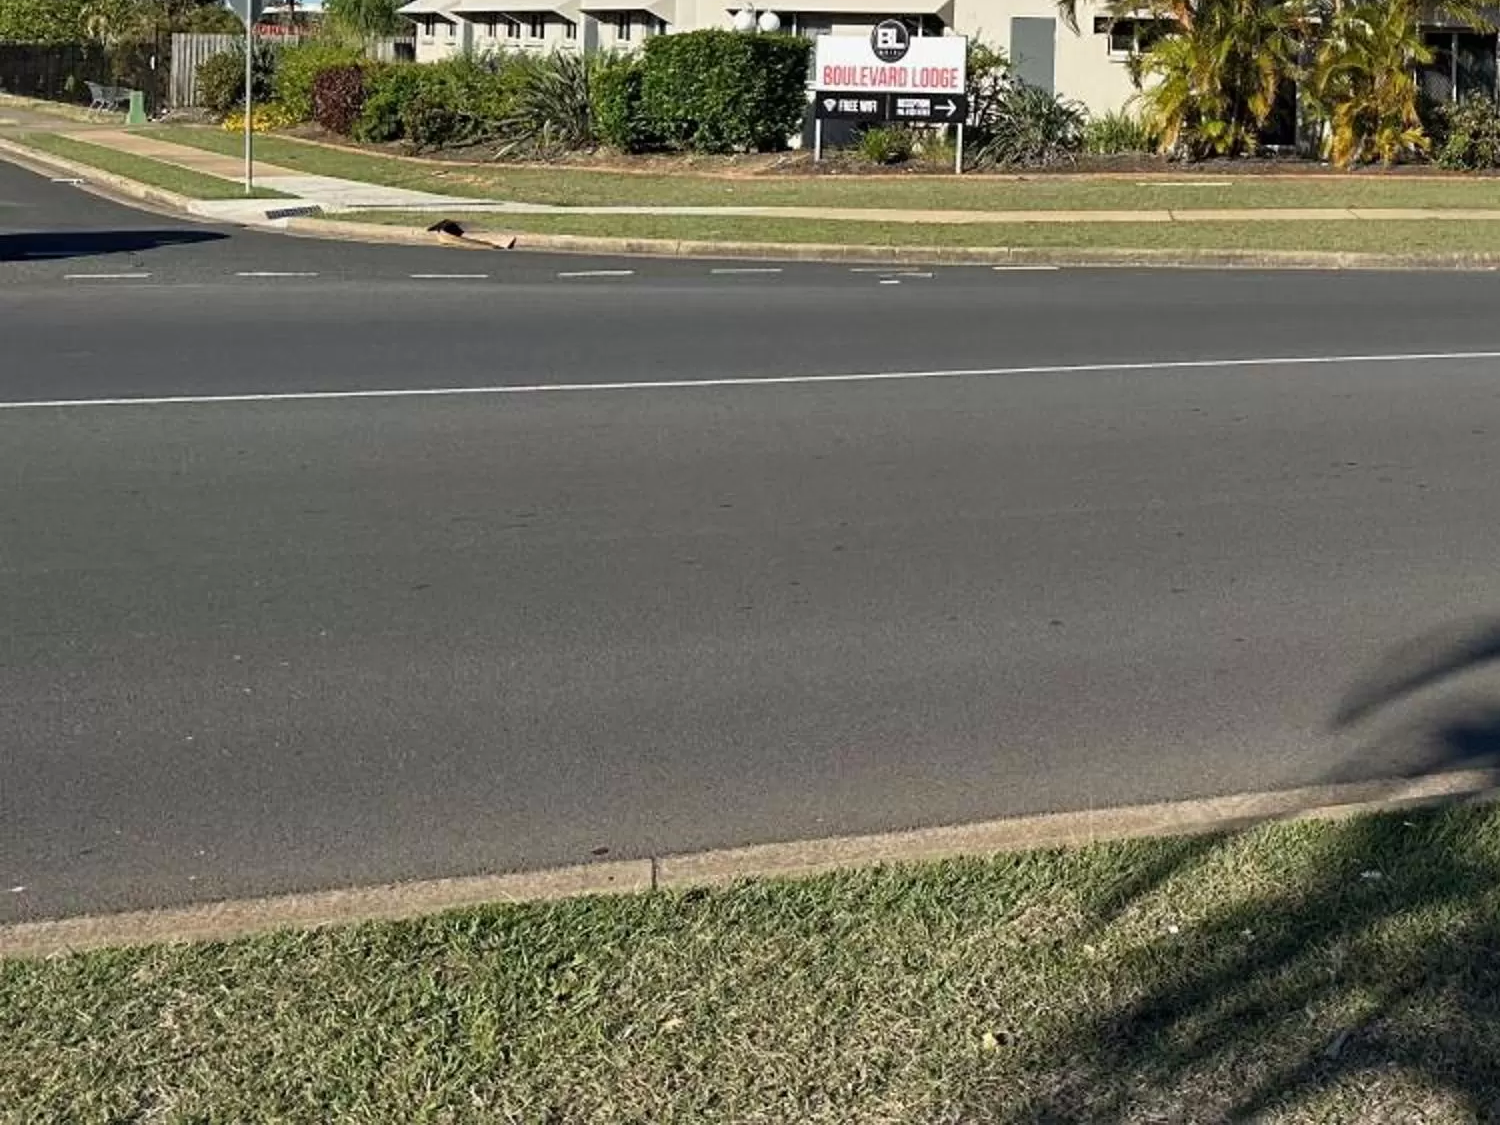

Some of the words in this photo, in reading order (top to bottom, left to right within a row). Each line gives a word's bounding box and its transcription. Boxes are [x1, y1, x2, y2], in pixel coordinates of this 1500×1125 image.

[877, 28, 905, 49] BL
[823, 65, 908, 87] BOULEVARD
[912, 67, 959, 88] LODGE
[838, 98, 858, 112] FREE
